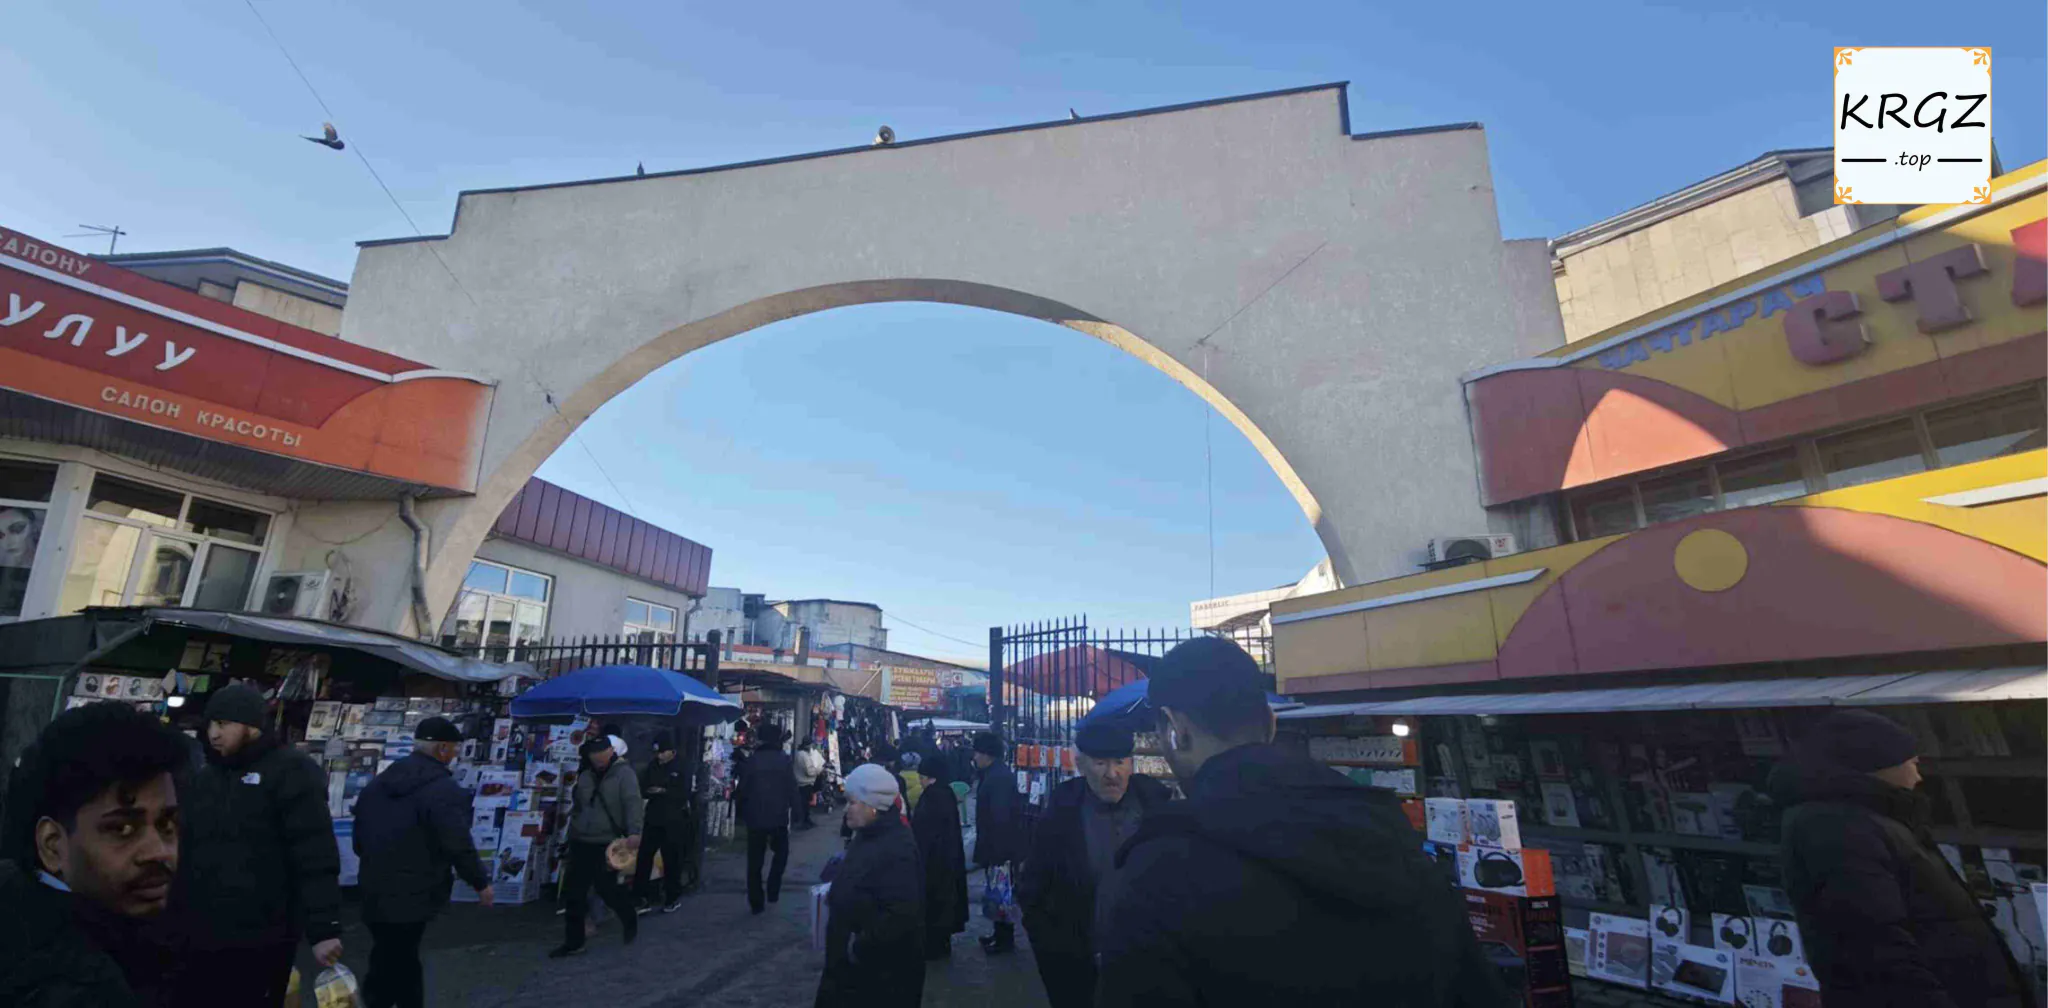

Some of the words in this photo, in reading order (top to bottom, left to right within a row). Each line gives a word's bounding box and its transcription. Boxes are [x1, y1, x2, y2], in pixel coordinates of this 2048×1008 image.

[0, 233, 92, 275] АЛОНУ
[0, 292, 197, 371] УЛУУ
[101, 386, 181, 418] САЛОН
[196, 410, 303, 447] КРАСОТЫ
